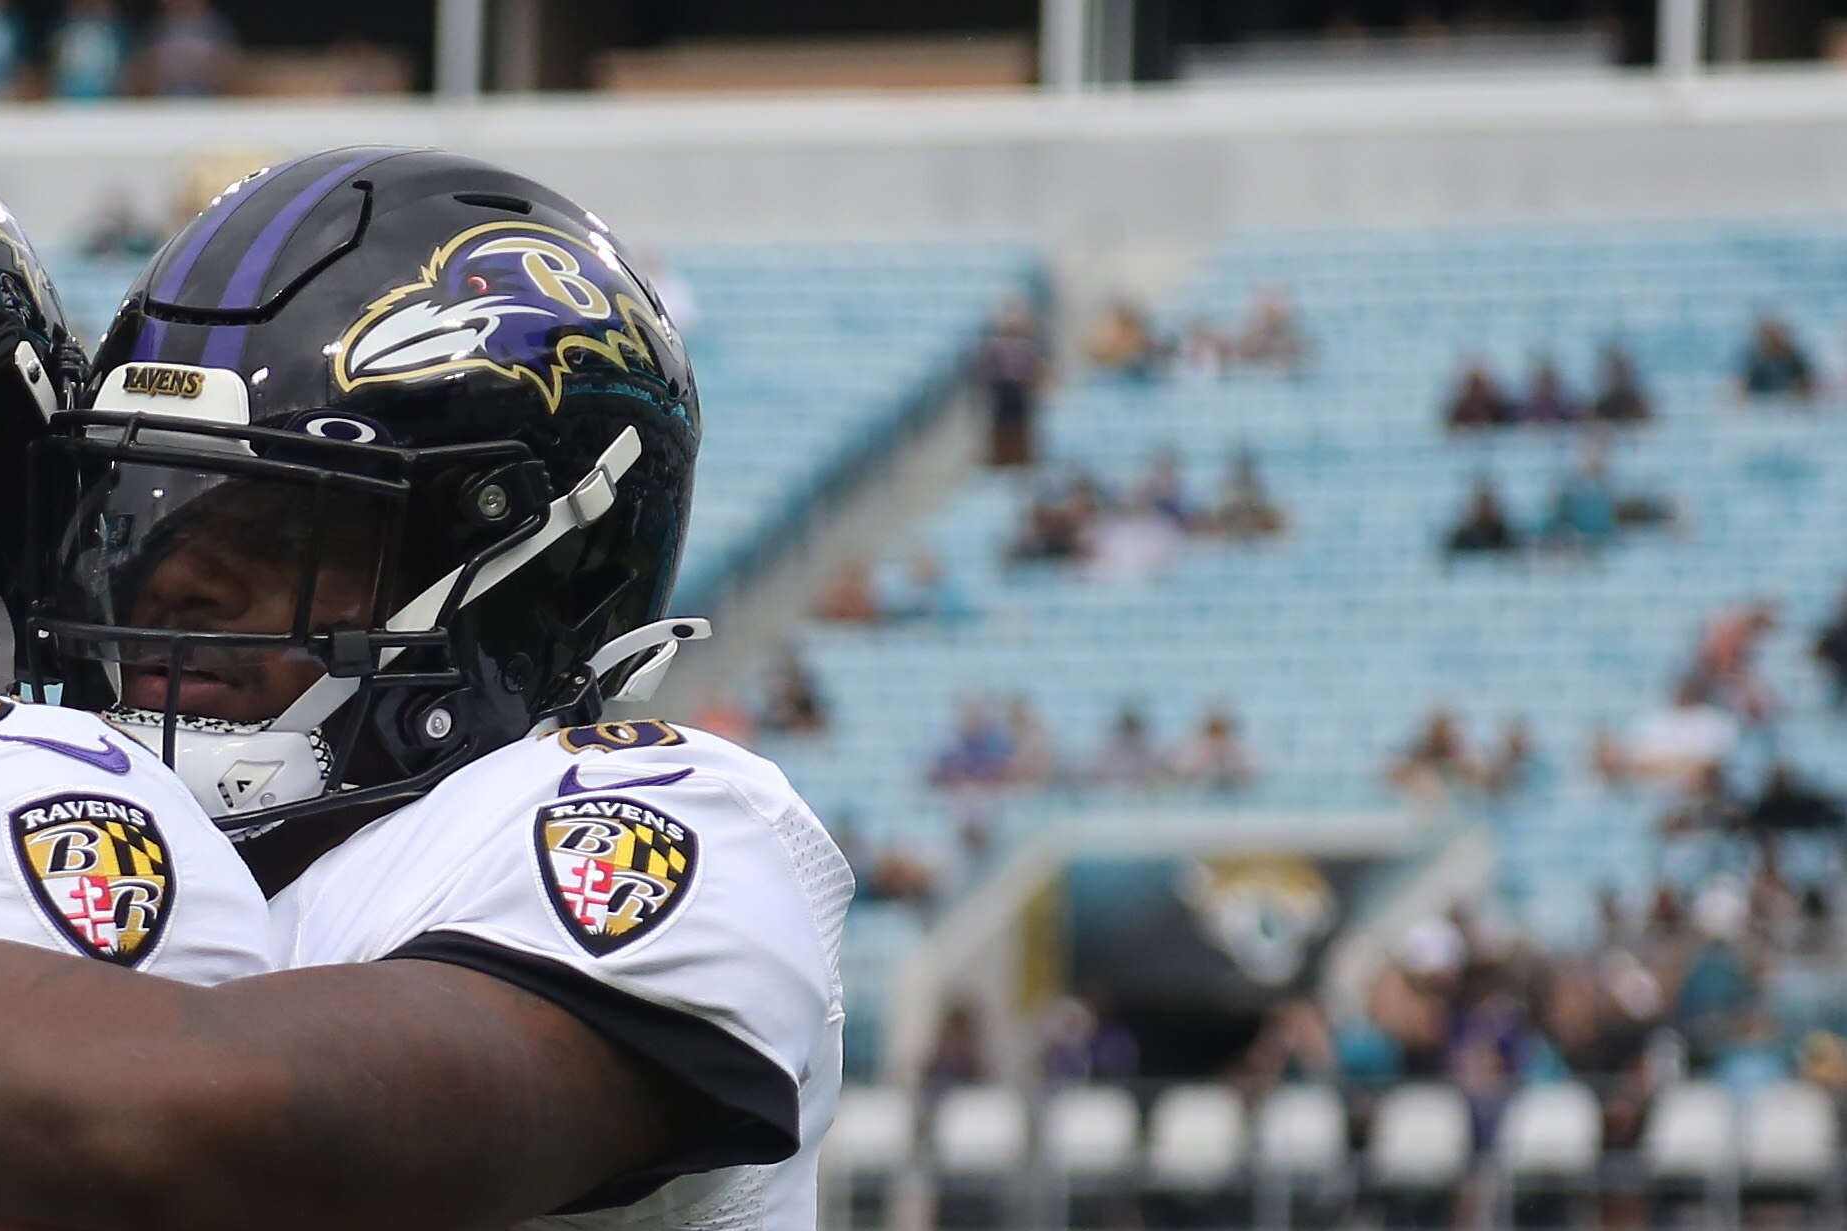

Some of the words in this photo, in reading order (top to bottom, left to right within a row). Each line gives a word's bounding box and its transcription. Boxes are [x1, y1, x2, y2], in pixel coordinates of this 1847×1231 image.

[123, 366, 206, 398] RAVENS
[20, 800, 147, 831] RAVENS
[550, 801, 685, 842] RAVENS
[29, 823, 102, 876] B
[547, 817, 626, 857] B
[108, 879, 161, 933] R
[607, 870, 670, 924] R
